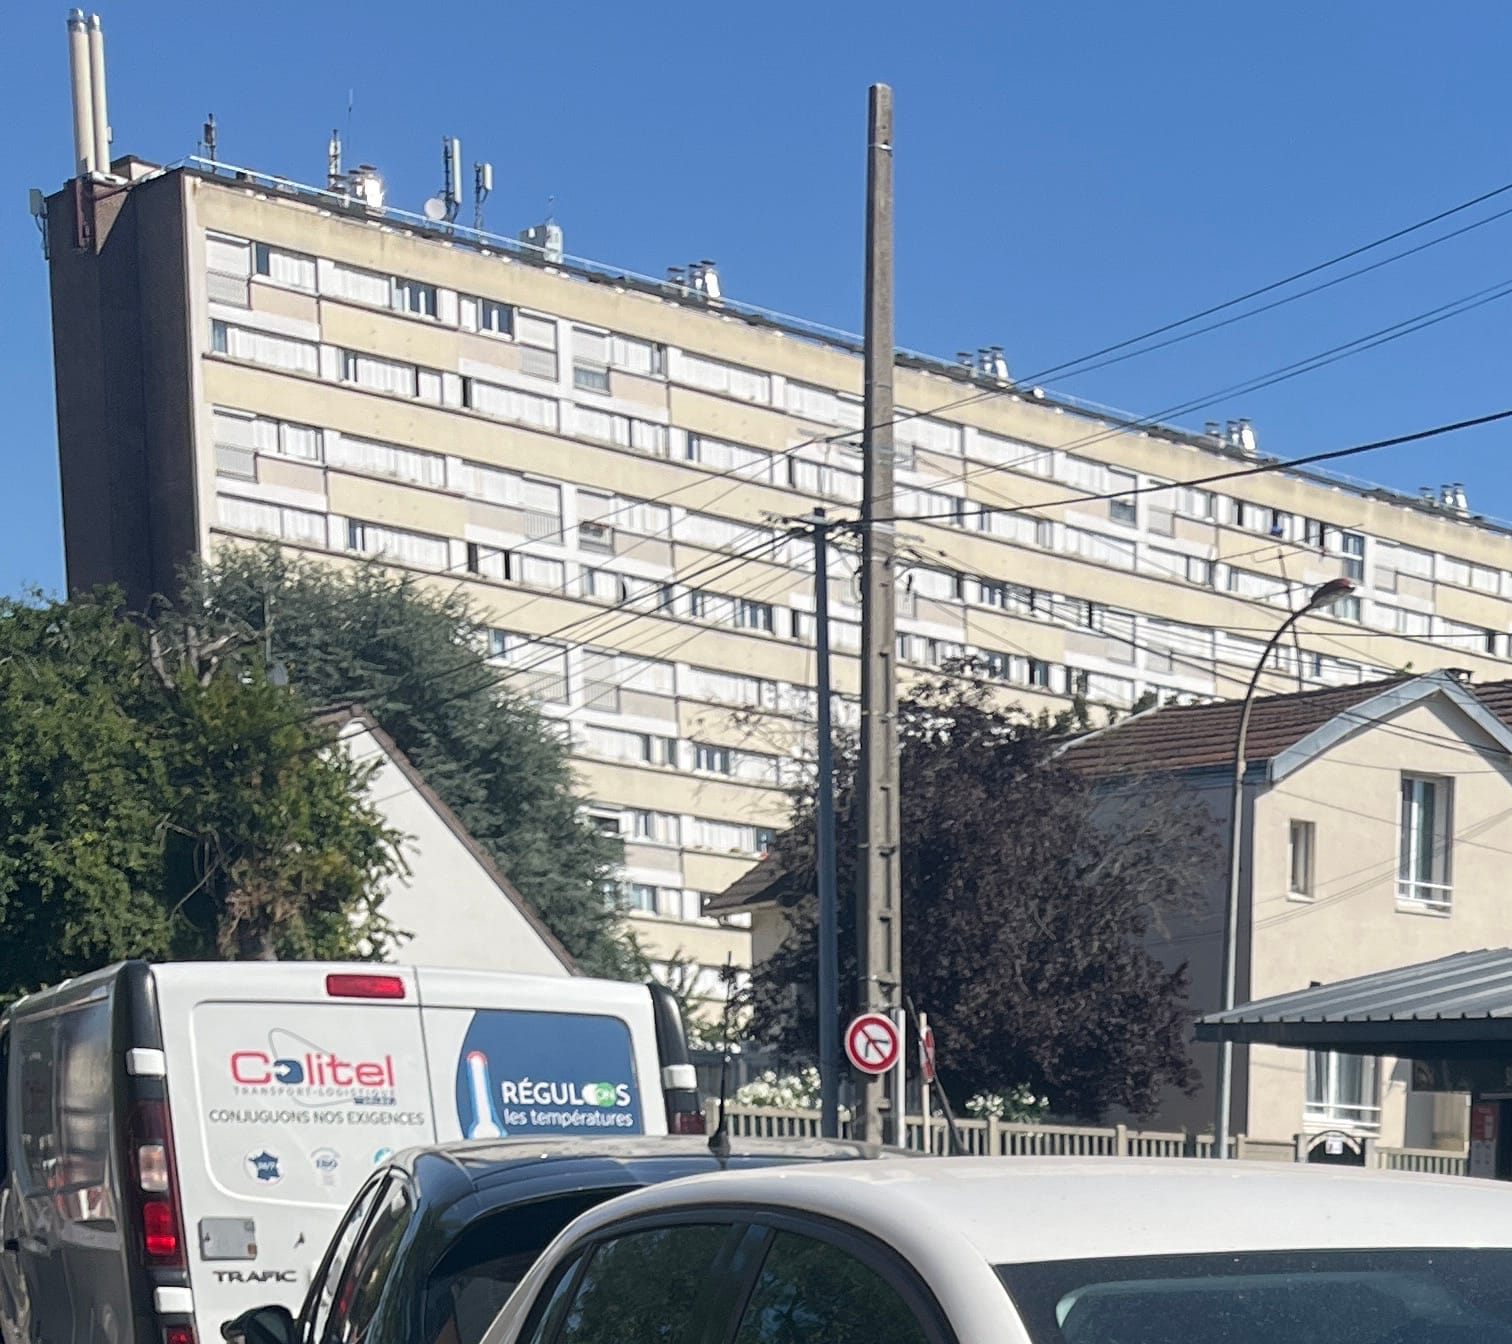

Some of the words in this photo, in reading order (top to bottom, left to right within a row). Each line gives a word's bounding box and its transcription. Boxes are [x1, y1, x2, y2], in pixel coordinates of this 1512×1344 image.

[209, 1109, 311, 1124] CONJUGUONS
[314, 1110, 344, 1124] NOS
[347, 1111, 425, 1126] EXIGENCES
[504, 1109, 528, 1125] les
[530, 1109, 633, 1128] températures
[213, 1270, 298, 1283] TRAFIC
